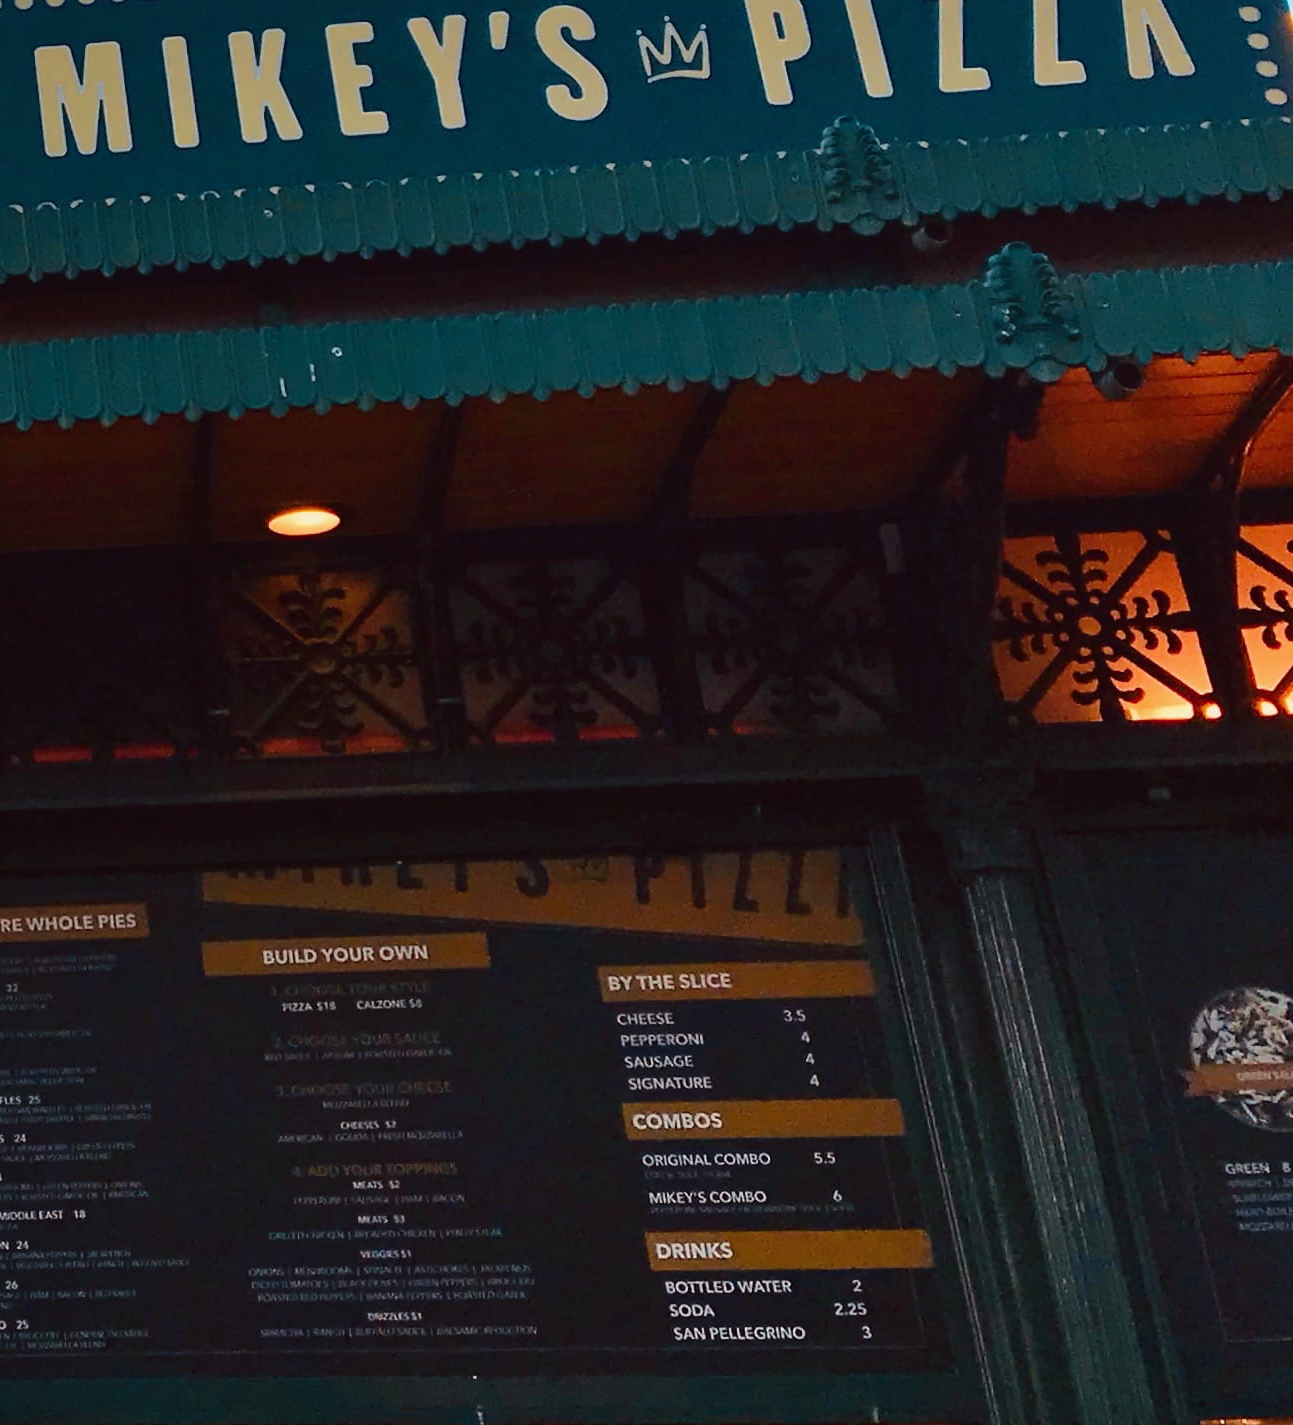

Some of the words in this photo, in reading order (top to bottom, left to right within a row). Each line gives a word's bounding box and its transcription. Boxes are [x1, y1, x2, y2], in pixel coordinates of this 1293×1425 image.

[33, 4, 609, 158] MIKEY'S
[26, 914, 94, 933] WHOLE
[98, 913, 137, 929] PIES
[262, 948, 318, 966] BUILD
[320, 946, 375, 964] YOUR
[378, 944, 429, 962] OWN
[607, 974, 633, 992] BY
[636, 974, 675, 991] THE
[678, 972, 733, 990] SLICE
[281, 1002, 314, 1013] PIZZA
[316, 1001, 337, 1012] $18
[356, 999, 406, 1010] CALZONE
[616, 1012, 675, 1026] CHEESE
[783, 1009, 806, 1023] 3.5
[619, 1033, 704, 1047] PEPPERONI
[800, 1030, 811, 1044] 4
[623, 1054, 694, 1069] SAUSAGE
[804, 1052, 815, 1065] 4
[627, 1076, 713, 1091] SIGNATURE
[809, 1074, 820, 1087] 4
[28, 1095, 41, 1105] 25
[340, 1120, 380, 1130] CHEESES
[631, 1112, 724, 1130] COMBOS
[13, 1133, 27, 1143] 24
[642, 1152, 712, 1168] ORIGINAL
[713, 1151, 772, 1166] COMBO
[813, 1151, 837, 1164] 5.5
[1224, 1161, 1271, 1175] GREEN
[352, 1180, 384, 1190] MEATS
[648, 1190, 707, 1205] MIKEY'S
[708, 1189, 768, 1204] COMBO
[832, 1189, 843, 1202] 6
[38, 1210, 63, 1221] EAST
[73, 1209, 87, 1220] 18
[357, 1214, 389, 1224] MEATS
[16, 1240, 30, 1251] 24
[654, 1240, 734, 1260] DRINKS
[359, 1249, 400, 1260] VEGGIES
[4, 1280, 19, 1291] 26
[664, 1279, 735, 1294] BOTTLED
[736, 1279, 793, 1293] WATER
[851, 1279, 863, 1293] 2
[367, 1311, 410, 1321] DRIZZLES
[668, 1304, 716, 1318] SODA
[833, 1302, 868, 1317] 2.25
[15, 1320, 29, 1330] 25
[672, 1326, 707, 1341] SAN
[708, 1326, 807, 1341] PELLEGRINO
[861, 1325, 873, 1339] 3
